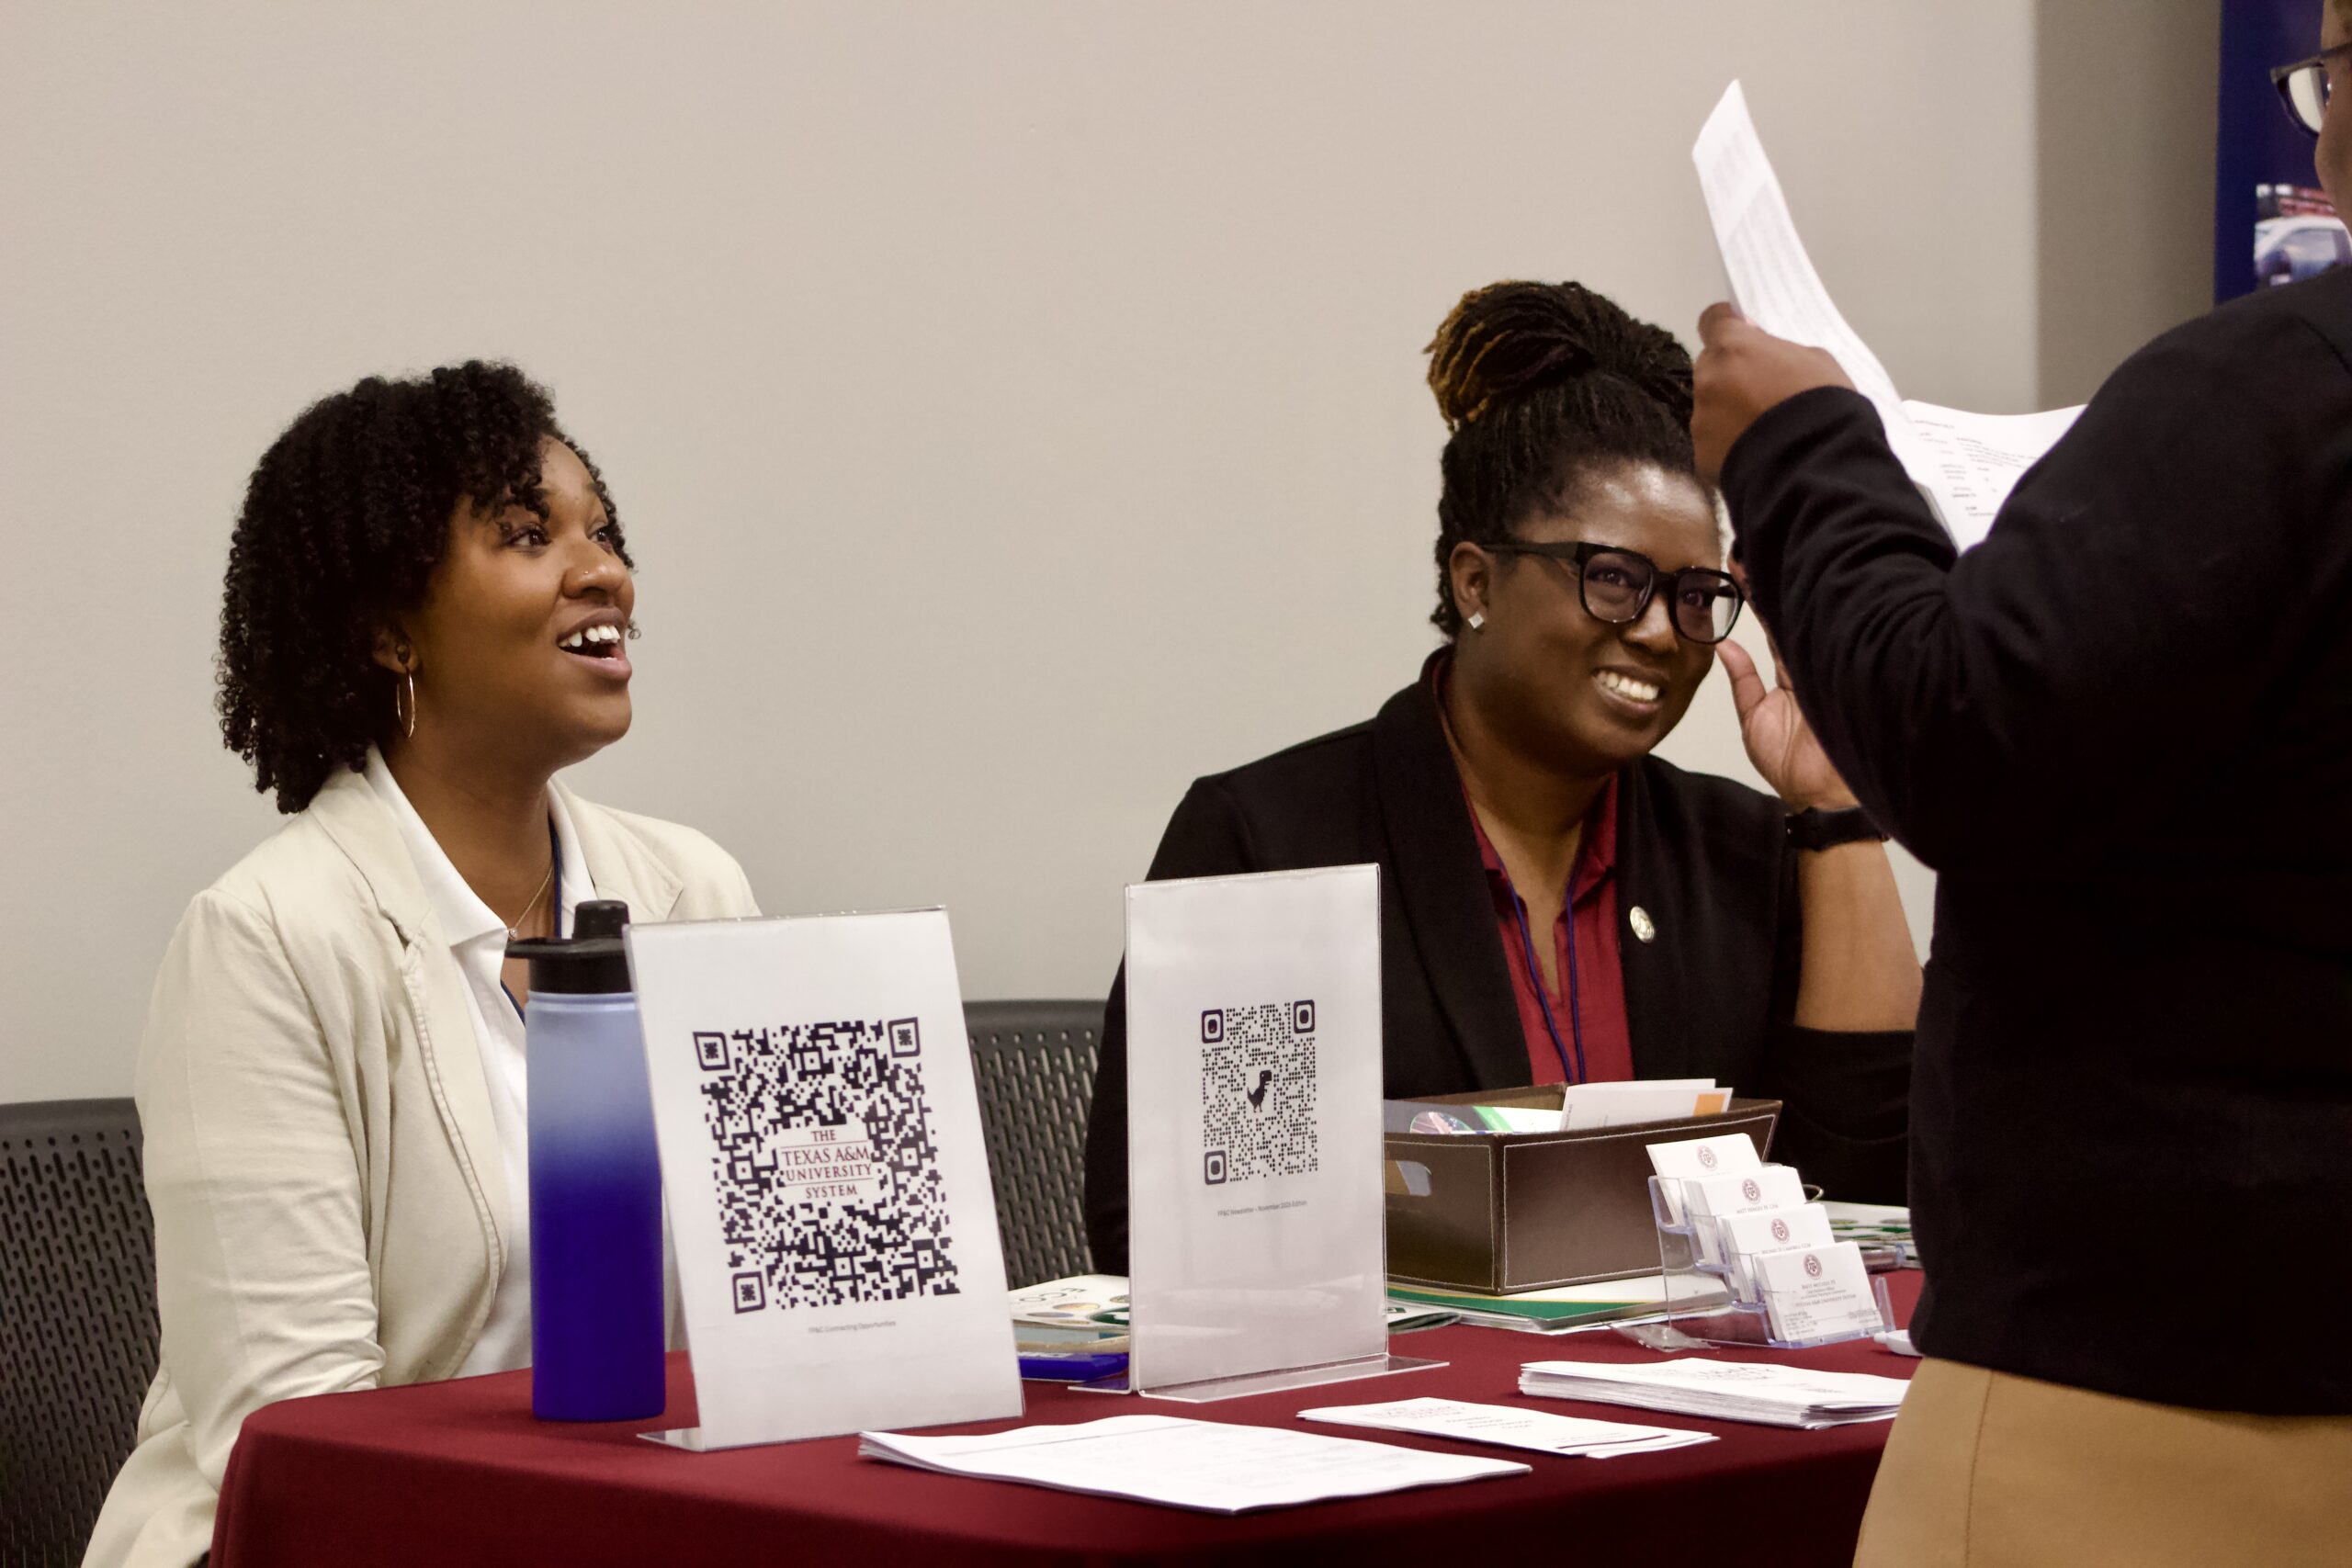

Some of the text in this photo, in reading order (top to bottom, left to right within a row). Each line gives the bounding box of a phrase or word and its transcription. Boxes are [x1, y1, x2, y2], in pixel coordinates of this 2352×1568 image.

[811, 1129, 836, 1142] THE
[781, 1145, 870, 1166] TEXAS A&M
[786, 1163, 872, 1181] UNIVERSITY
[805, 1184, 857, 1199] SYSTEM
